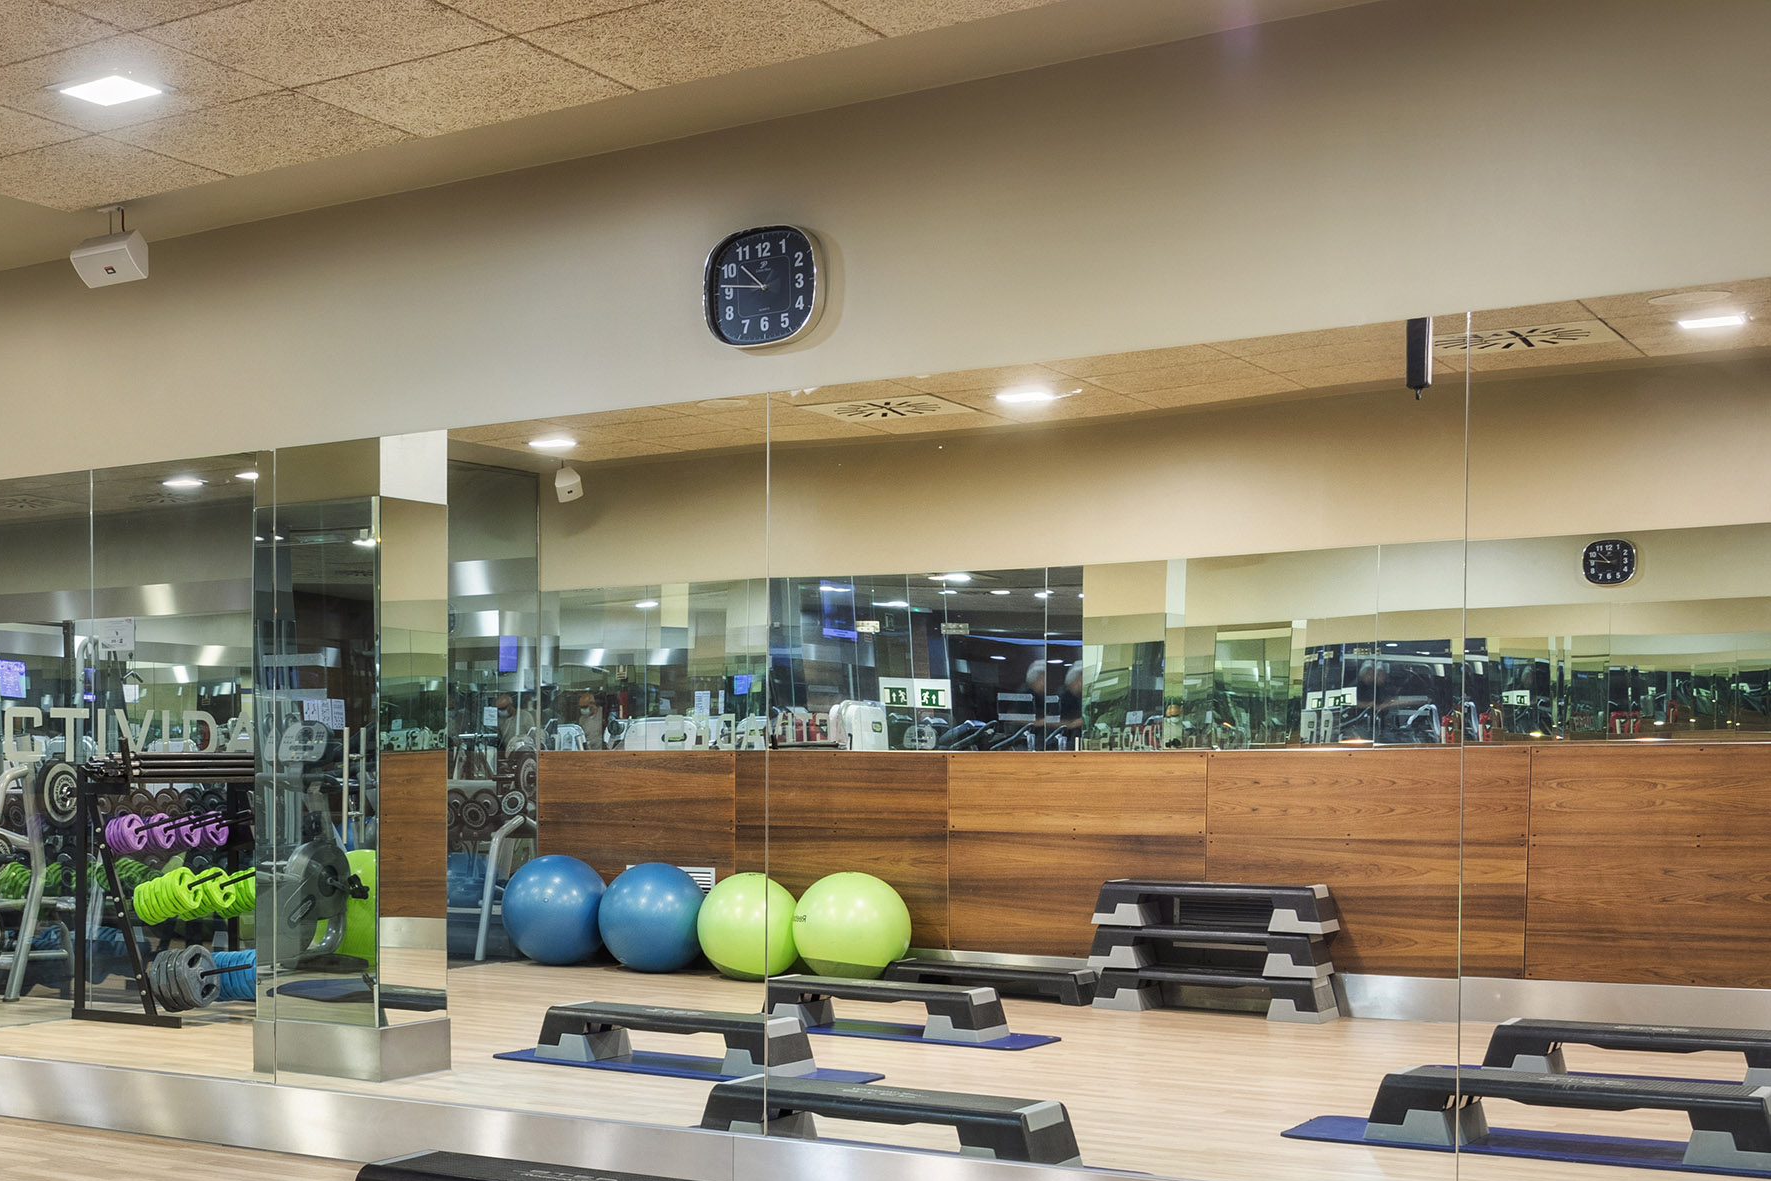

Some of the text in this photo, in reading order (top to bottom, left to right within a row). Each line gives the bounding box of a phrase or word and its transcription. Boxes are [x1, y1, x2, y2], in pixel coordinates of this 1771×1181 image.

[736, 245, 750, 261] 11
[755, 242, 771, 258] 12
[779, 239, 786, 253] 1
[794, 252, 804, 267] 2
[721, 263, 737, 279] 10
[795, 273, 804, 288] 3
[724, 287, 734, 300] 9
[794, 295, 805, 310] 4
[725, 306, 734, 320] 8
[780, 313, 789, 328] 5
[741, 319, 750, 334] 7
[760, 316, 769, 331] 6
